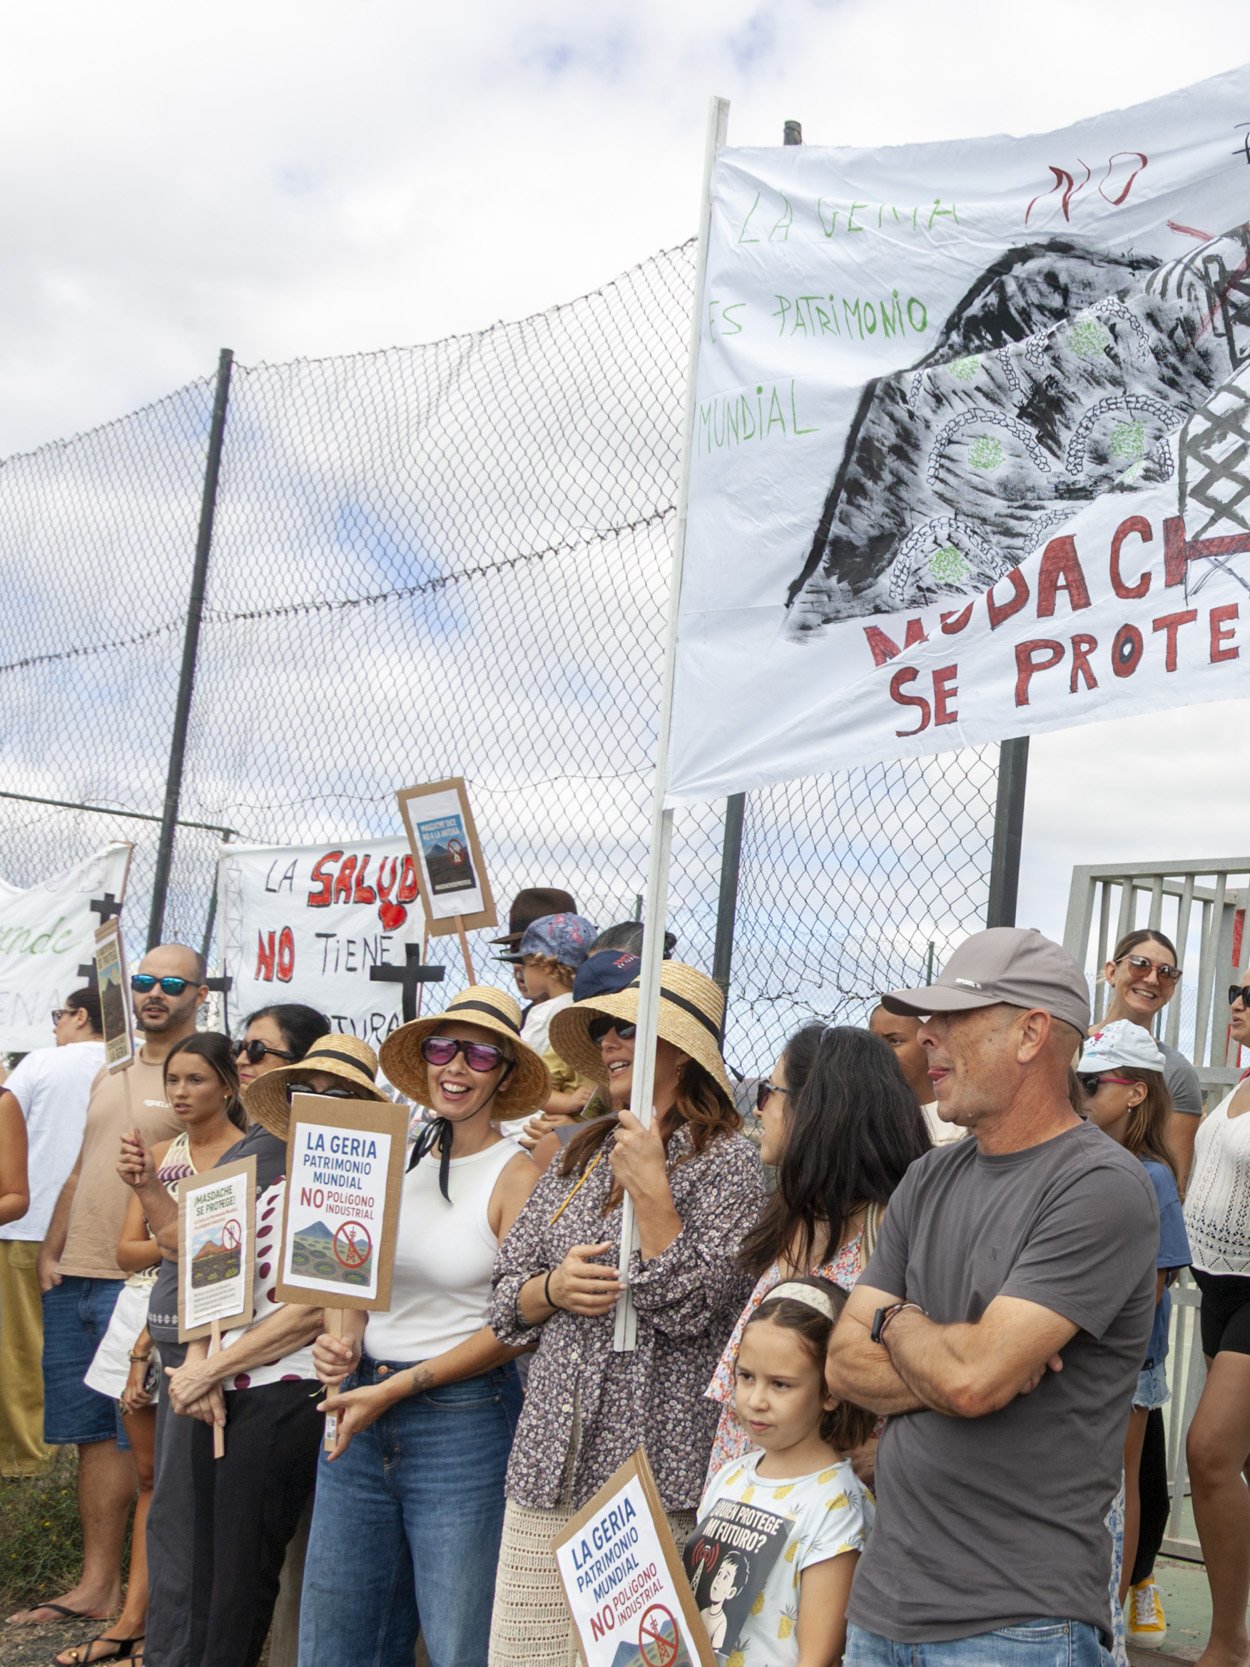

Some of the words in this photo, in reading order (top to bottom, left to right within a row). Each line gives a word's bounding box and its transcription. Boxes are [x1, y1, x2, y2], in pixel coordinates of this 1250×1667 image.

[738, 191, 792, 243] LA
[709, 301, 746, 344] ES
[889, 663, 958, 737] SE
[265, 859, 298, 894] LA
[307, 850, 419, 907] SALUD
[254, 925, 295, 983] NO
[303, 1154, 372, 1175] PATRIMONIO
[307, 1132, 325, 1152] LA
[330, 1135, 377, 1159] GERIA
[300, 1187, 324, 1209] NO
[313, 1171, 362, 1190] MUNDIAL
[196, 1205, 204, 1216] SE
[325, 1203, 374, 1220] INDUSTRIAL
[571, 1539, 593, 1571] LA
[592, 1497, 636, 1551] GERIA
[702, 1518, 719, 1538] MI
[715, 1521, 767, 1554] FUTURO?
[735, 1506, 783, 1536] PROTEGE
[576, 1527, 639, 1593] PATRIMONIO
[593, 1553, 640, 1603] MUNDIAL
[617, 1578, 664, 1626] INDUSTRIAL
[590, 1604, 615, 1642] NO
